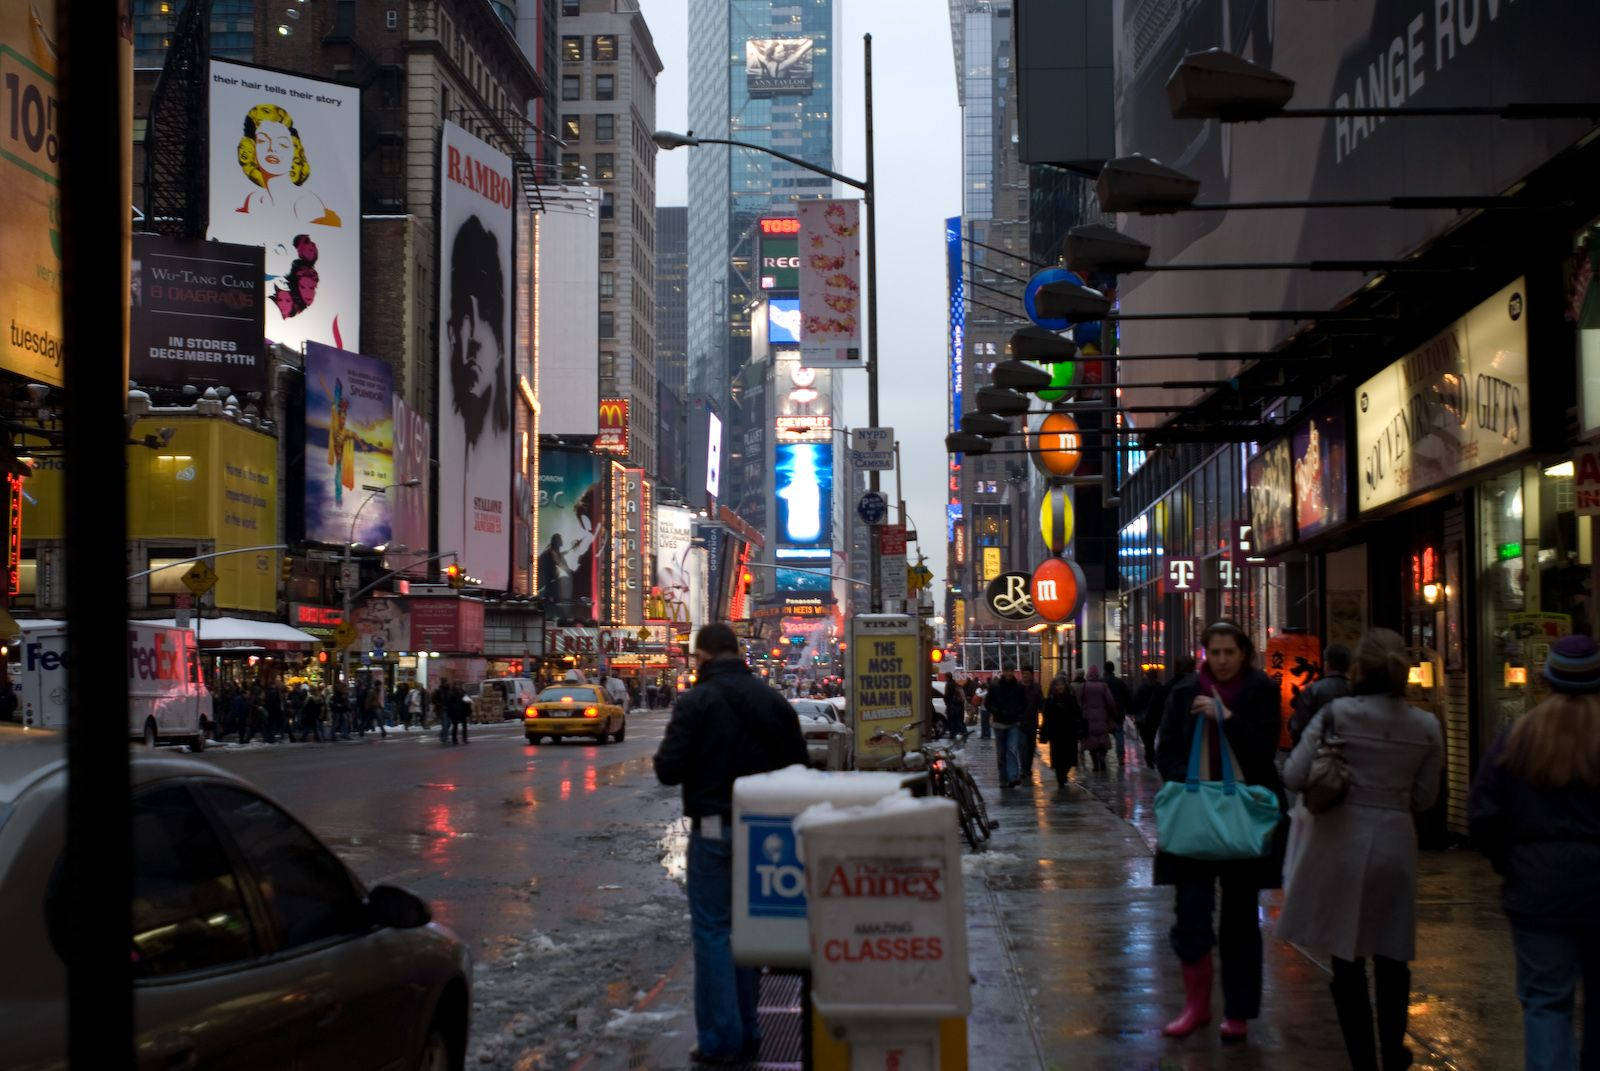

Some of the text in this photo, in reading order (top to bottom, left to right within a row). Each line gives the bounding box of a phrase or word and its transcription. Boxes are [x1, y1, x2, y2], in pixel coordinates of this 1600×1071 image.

[213, 74, 343, 107] their hair tells their story
[753, 79, 807, 87] ANN TAYLOR
[1335, 12, 1426, 165] RANGE
[6, 73, 45, 153] 10
[448, 144, 512, 210] RAMBO
[168, 336, 237, 352] IN STORES
[149, 347, 256, 366] DECEMBER 11TH
[1476, 372, 1522, 446] GIFTS
[859, 431, 888, 439] NYPD
[852, 450, 893, 459] SECURITY
[626, 481, 637, 590] PALACE
[659, 526, 690, 536] MAXIMUM
[659, 540, 677, 549] LIVES
[710, 528, 718, 571] VORNADO
[1169, 560, 1195, 588] T
[1037, 579, 1058, 601] m
[874, 641, 897, 656] THE
[869, 658, 904, 673] MOST
[859, 674, 912, 690] TRUSTED
[860, 689, 913, 706] NAME IN
[822, 865, 943, 901] Annex
[854, 921, 912, 935] AMAZING
[823, 937, 943, 963] CLASSES
